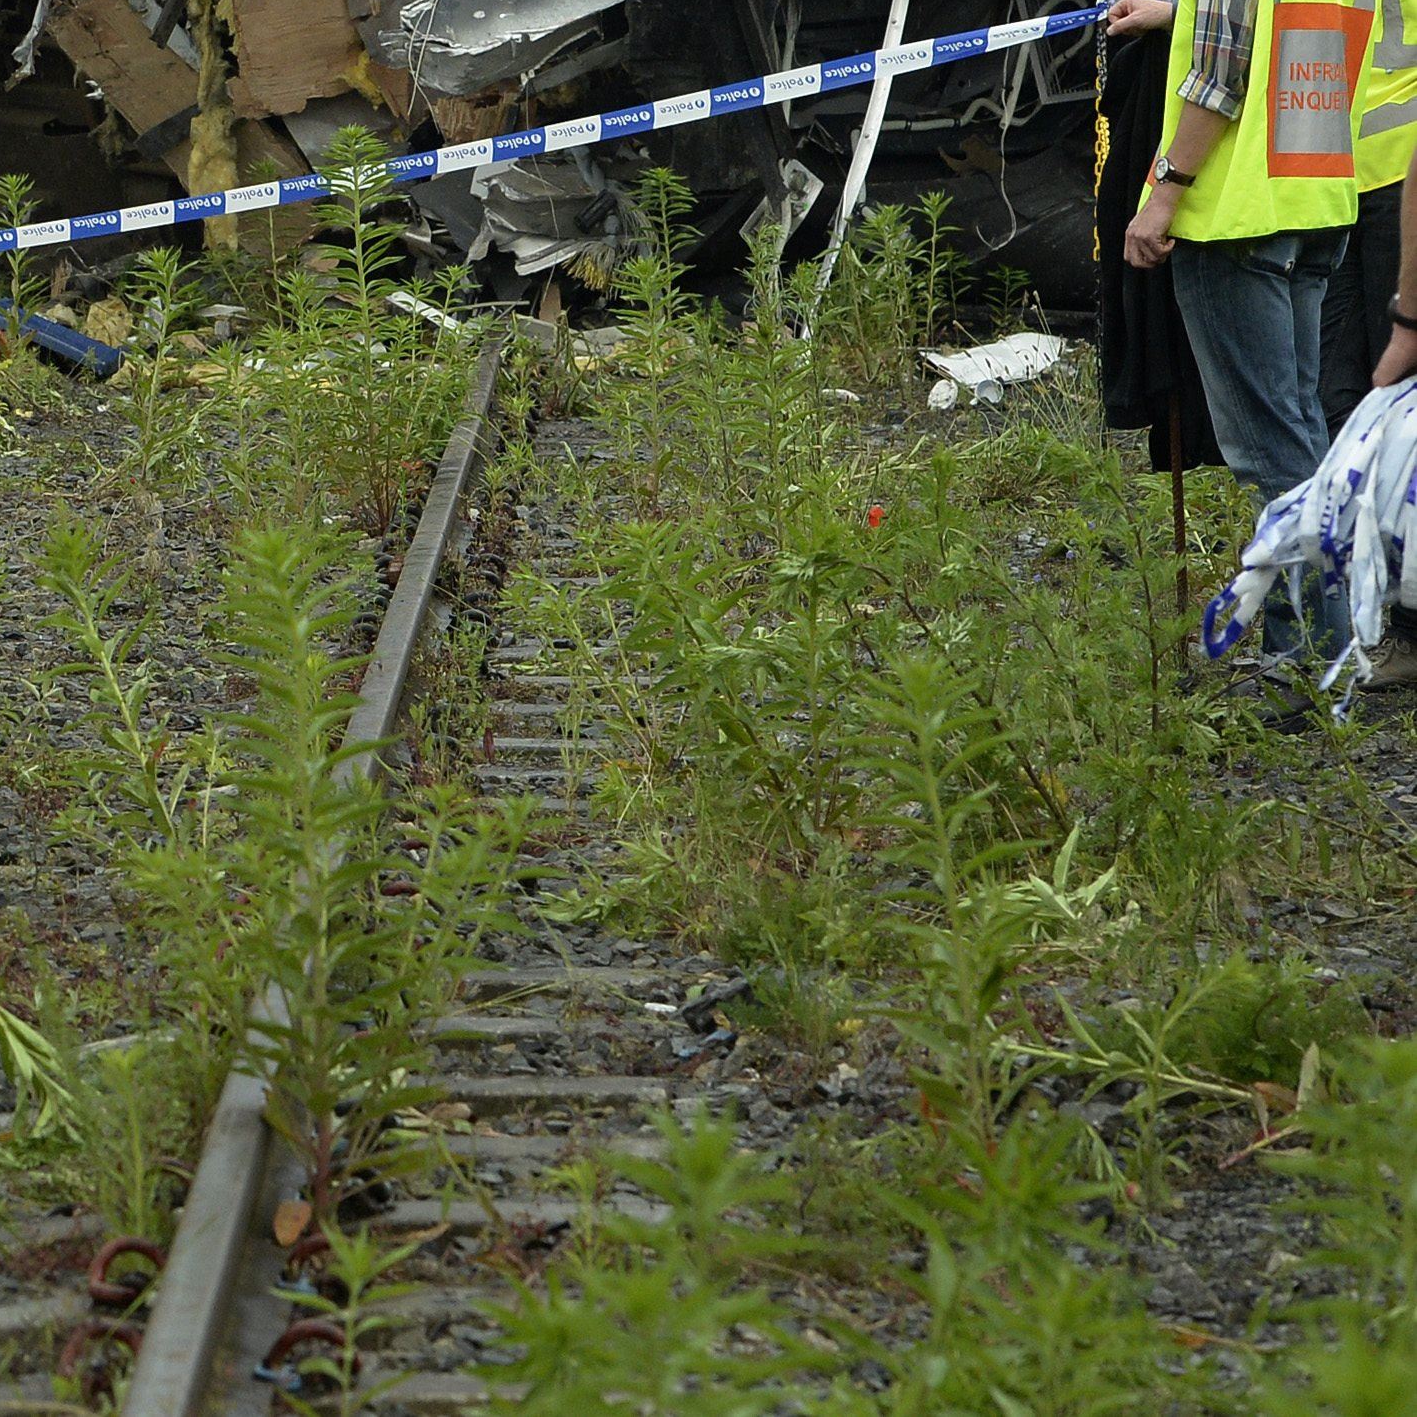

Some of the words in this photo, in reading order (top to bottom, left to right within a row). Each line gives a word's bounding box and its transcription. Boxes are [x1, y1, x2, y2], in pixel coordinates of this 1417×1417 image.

[22, 226, 54, 237] Police
[73, 217, 106, 229] Police
[126, 208, 159, 219] Police
[177, 198, 211, 210] Police
[231, 189, 263, 201] Police
[283, 178, 316, 191] Police
[444, 147, 476, 160] Police
[497, 136, 530, 149] Police
[551, 125, 584, 138] Police
[604, 113, 639, 127] Police
[660, 102, 694, 114] Police
[714, 89, 749, 103] Police
[770, 77, 804, 90] Police
[825, 65, 860, 78] Police
[881, 52, 915, 65] Police
[936, 41, 972, 53] Police
